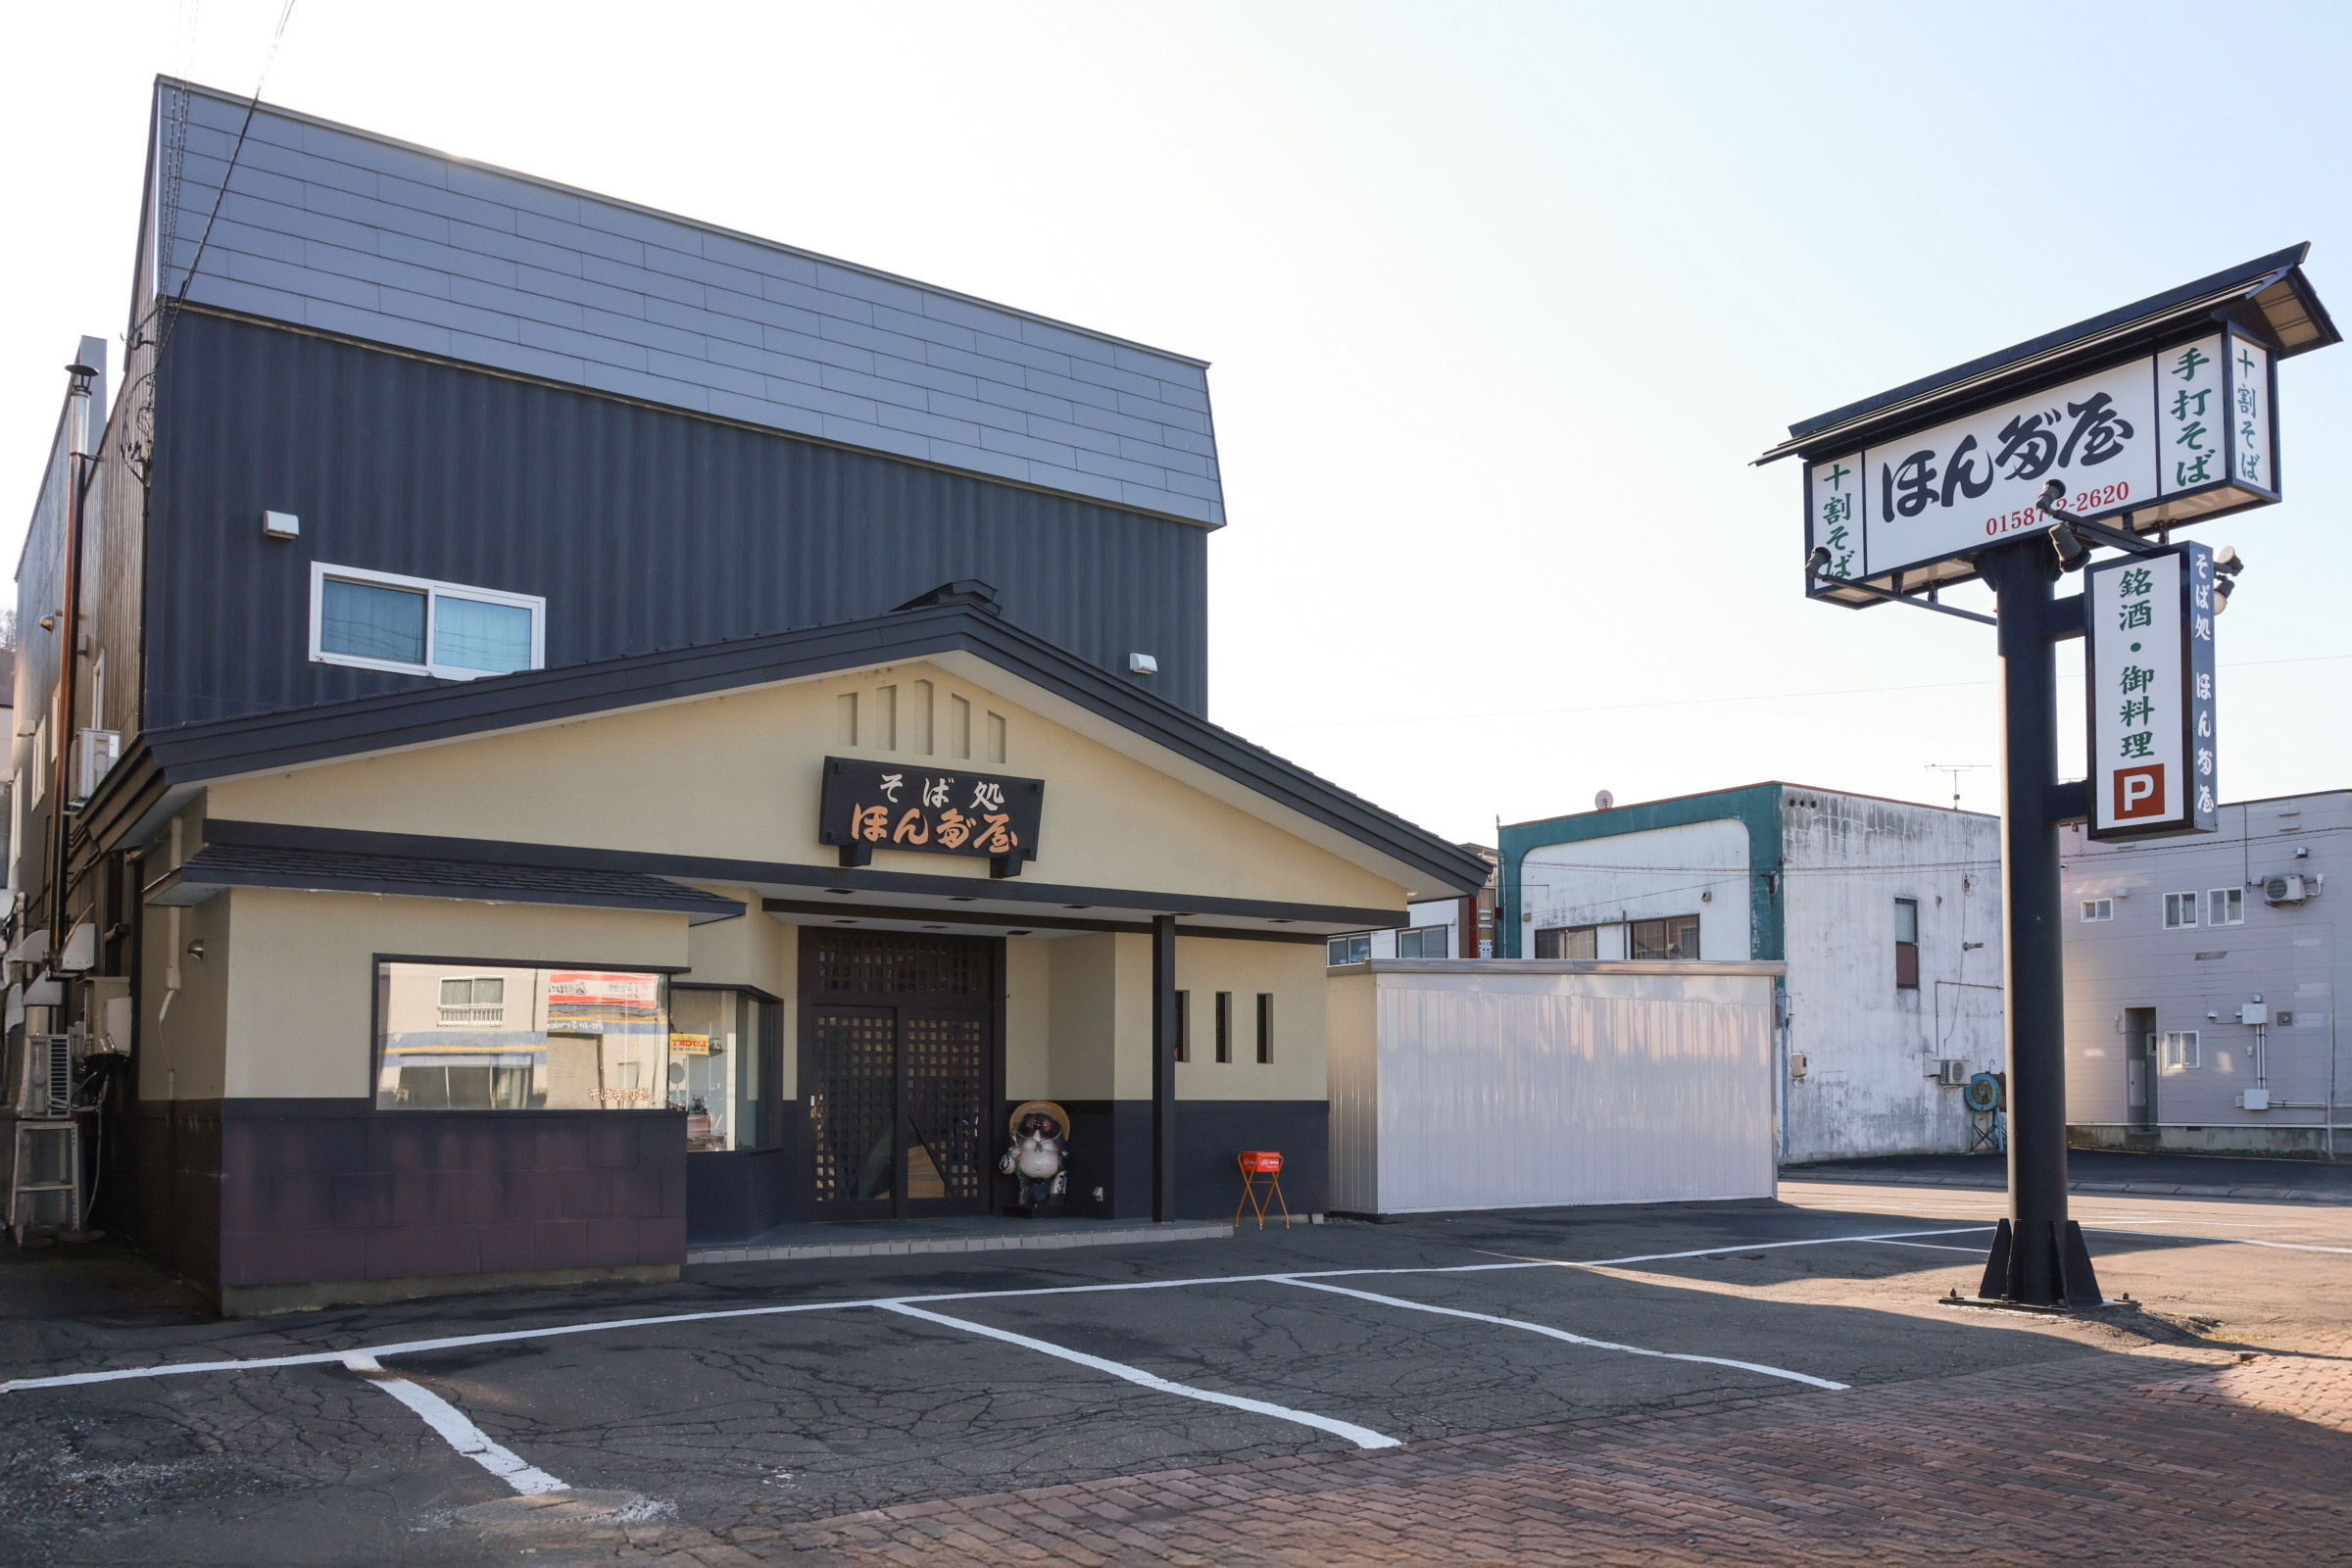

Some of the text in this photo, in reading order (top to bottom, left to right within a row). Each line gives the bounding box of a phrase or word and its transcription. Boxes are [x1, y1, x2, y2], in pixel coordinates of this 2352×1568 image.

[2170, 347, 2216, 487] 手打そば
[2237, 348, 2260, 482] 十割そば
[1823, 464, 1855, 578] 十割そば
[2195, 553, 2211, 641] そば処
[2118, 567, 2155, 760] 銘酒・御料理
[880, 773, 1005, 811] そば処
[2124, 773, 2155, 812] P
